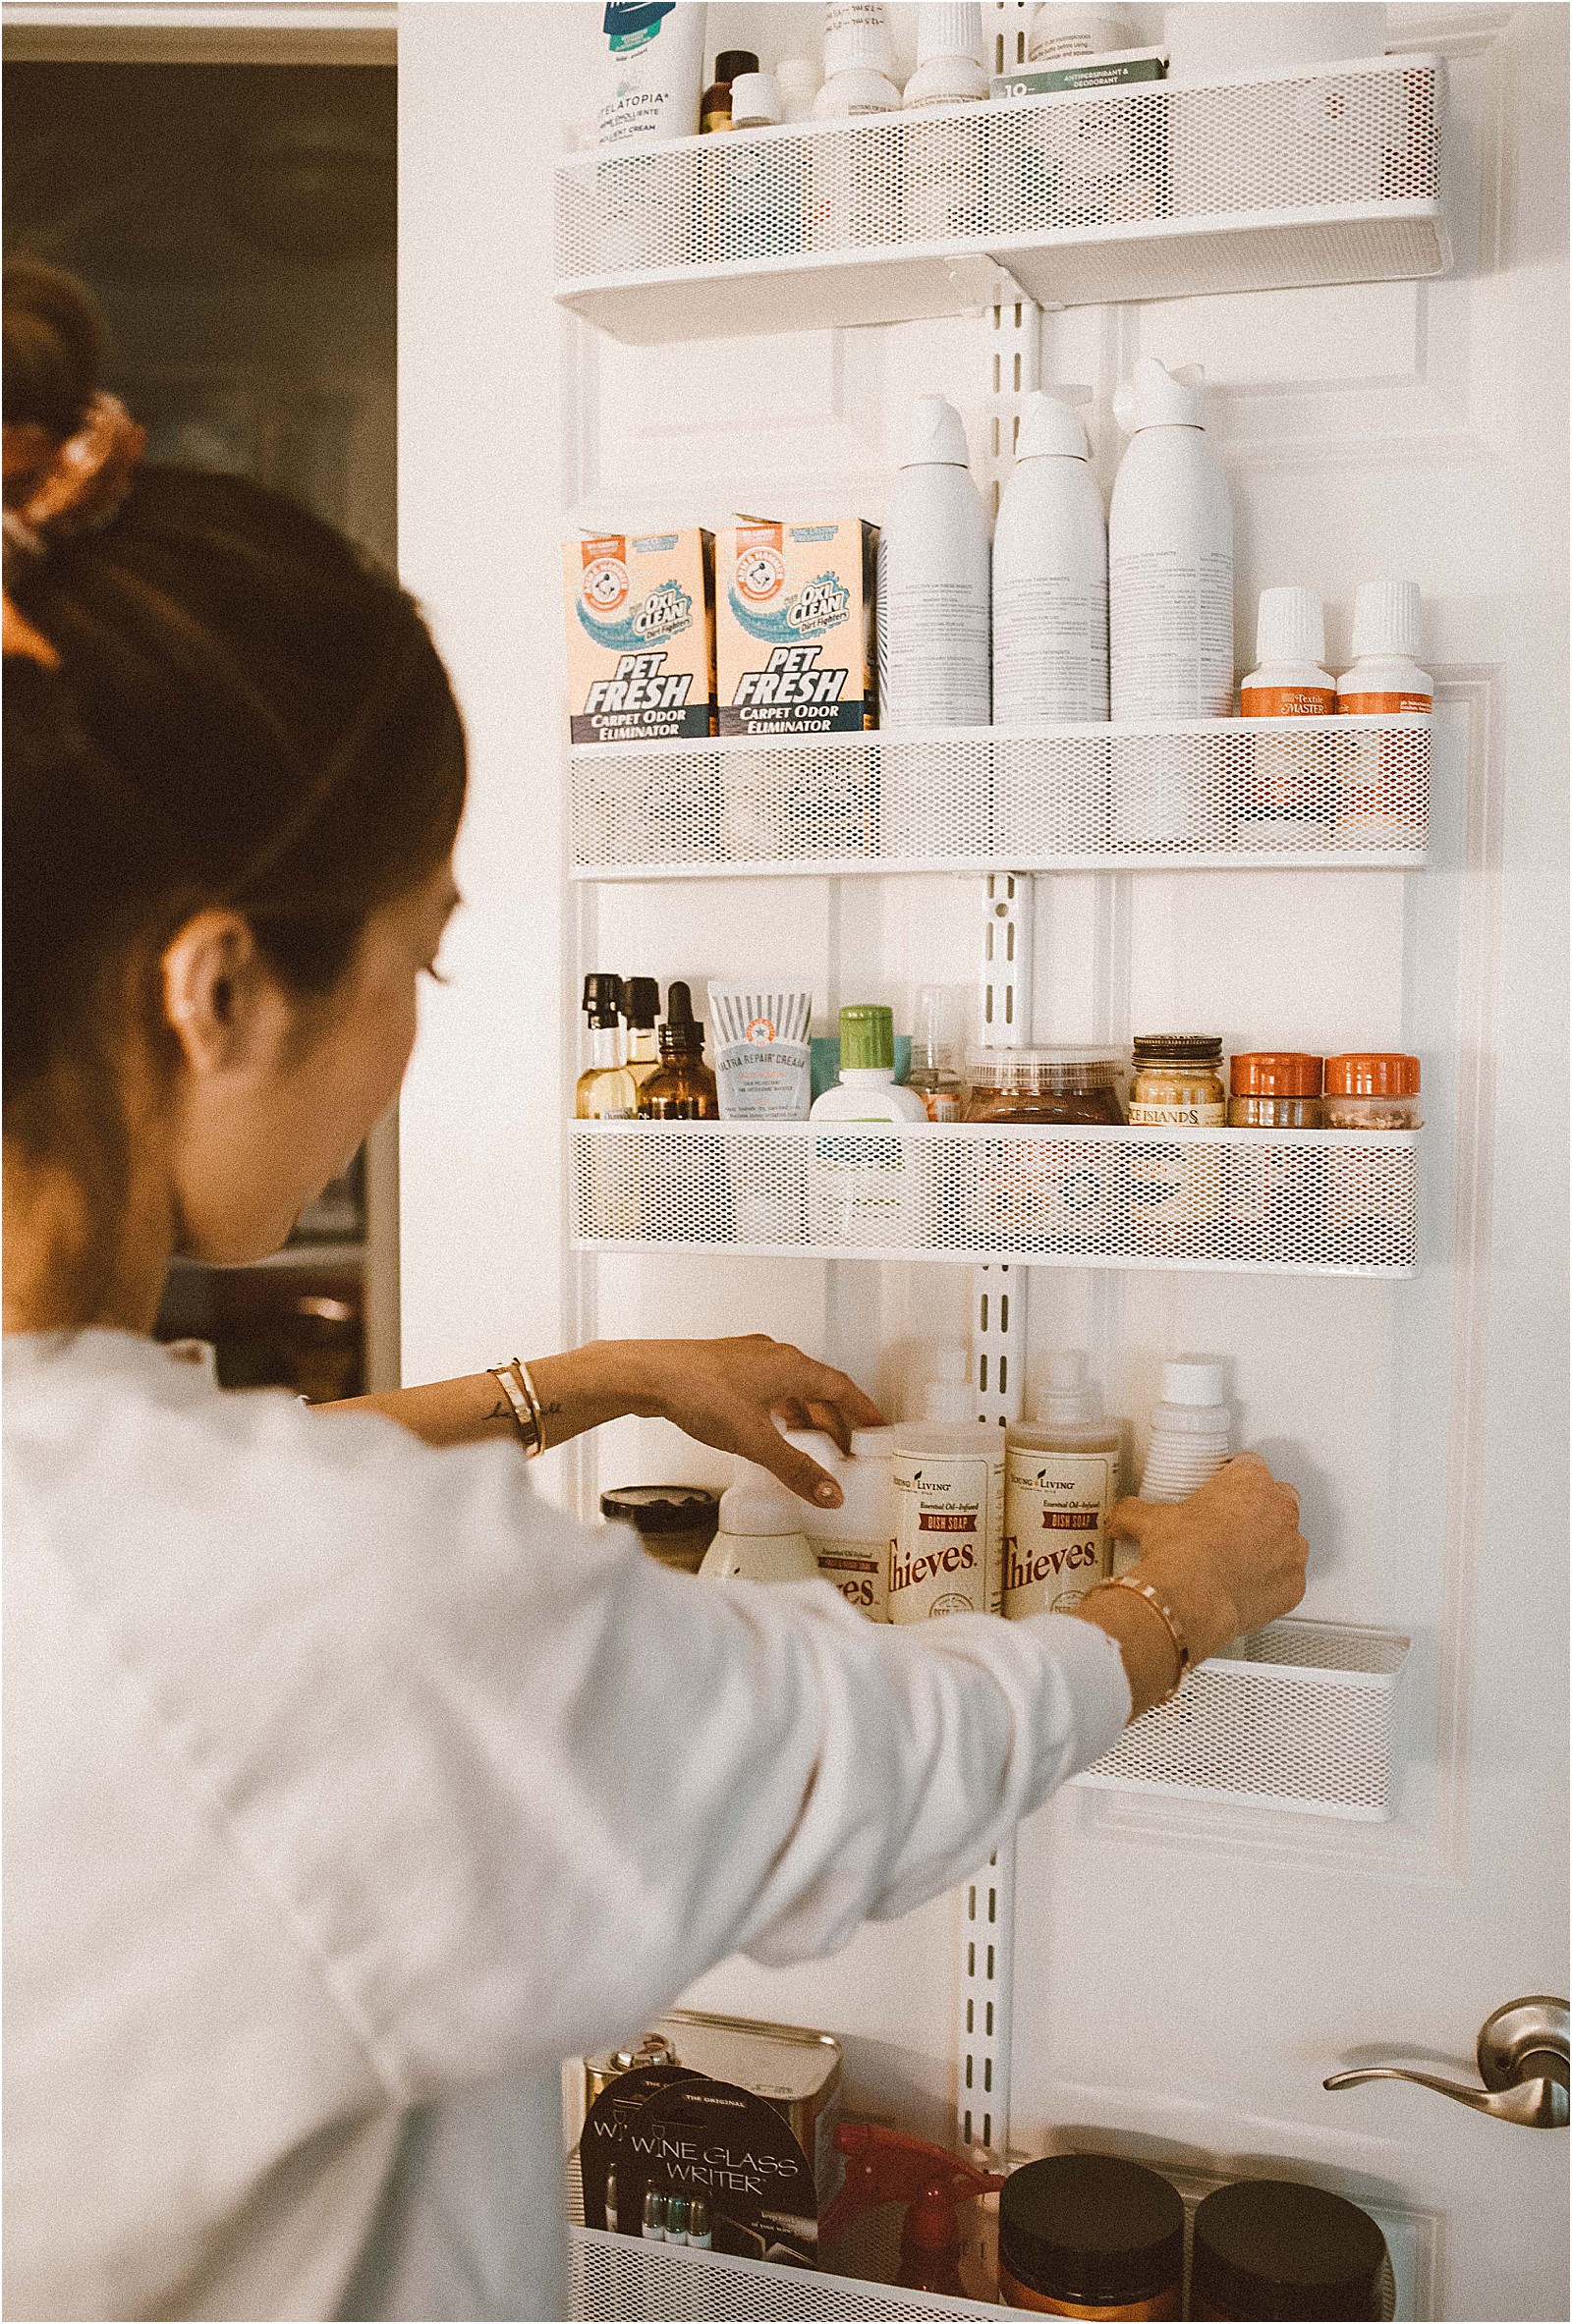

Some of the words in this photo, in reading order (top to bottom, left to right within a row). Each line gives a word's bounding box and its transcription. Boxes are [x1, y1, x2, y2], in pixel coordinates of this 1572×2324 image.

[1064, 70, 1122, 82] ANTIPERSPIRANT
[1074, 77, 1119, 88] DEODORANT
[646, 591, 674, 613] OXI
[803, 583, 830, 603] OXI
[635, 602, 685, 633] CLEAN
[789, 595, 842, 625] CLEAN
[614, 652, 668, 680] PET
[766, 646, 822, 673] PET
[585, 674, 693, 715] FRESH
[732, 669, 848, 705] FRESH
[590, 713, 641, 728] CARPET
[643, 710, 686, 724] ODOR
[740, 706, 792, 720] CARPET
[794, 705, 839, 718] ODOR
[599, 724, 680, 741] ELIMINATOR
[747, 720, 831, 735] ELIMINATOR
[718, 1057, 744, 1072] ULTRA
[776, 1054, 806, 1070] CREAM
[927, 1516, 946, 1529] DISH
[948, 1517, 968, 1529] SOAP
[1052, 1515, 1070, 1527] DISH
[1072, 1515, 1091, 1527] SOAP
[703, 2097, 746, 2108] ORIGINAL
[632, 2135, 698, 2161] WINE
[703, 2146, 799, 2178] GLASS
